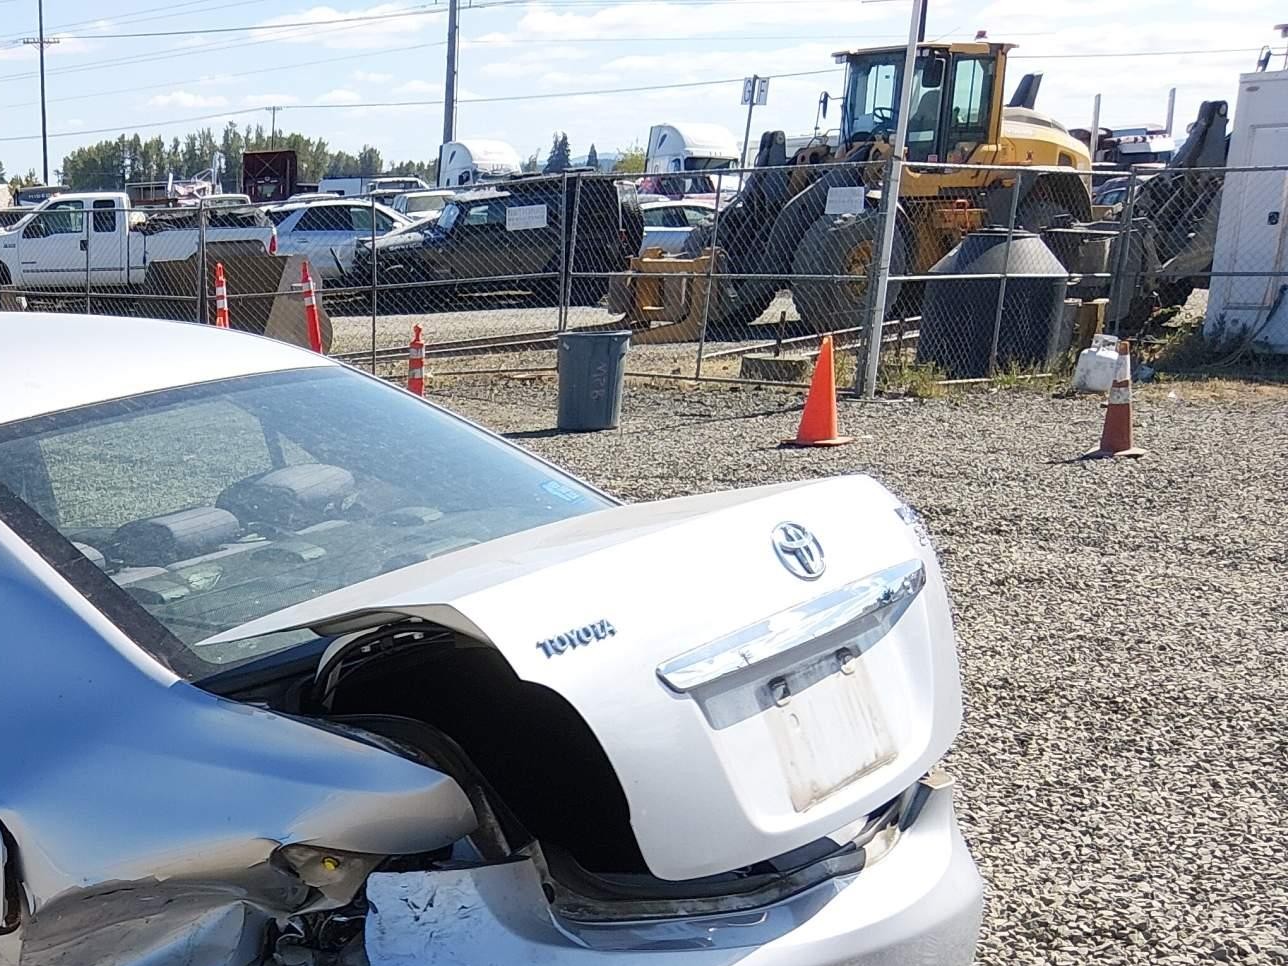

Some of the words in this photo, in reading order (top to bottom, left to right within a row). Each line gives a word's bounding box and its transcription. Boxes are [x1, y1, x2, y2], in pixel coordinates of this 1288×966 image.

[744, 79, 752, 103] G
[758, 79, 767, 103] F
[535, 618, 616, 659] TOYOTA
